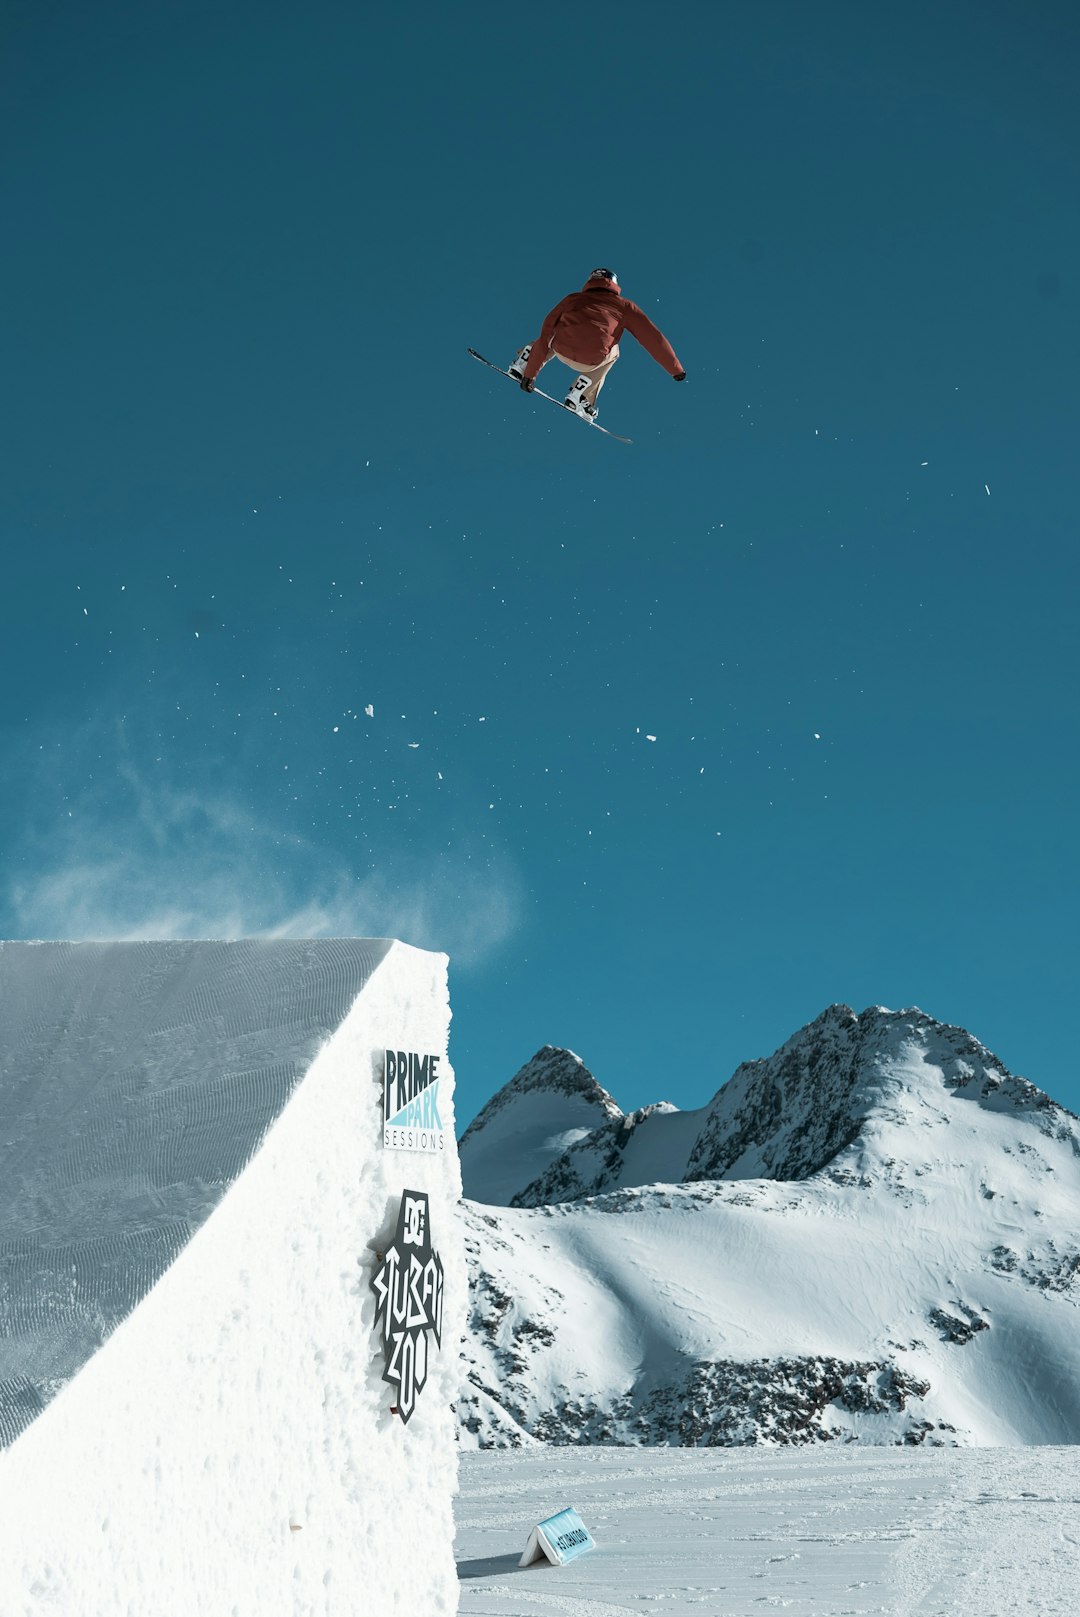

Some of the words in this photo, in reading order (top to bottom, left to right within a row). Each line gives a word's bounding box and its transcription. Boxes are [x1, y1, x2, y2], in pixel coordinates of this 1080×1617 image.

[386, 1050, 440, 1121] PRIME
[407, 1081, 443, 1131] PARK
[385, 1130, 444, 1150] SESSIONS
[373, 1246, 443, 1342] STUBAI
[387, 1329, 427, 1415] ZOO
